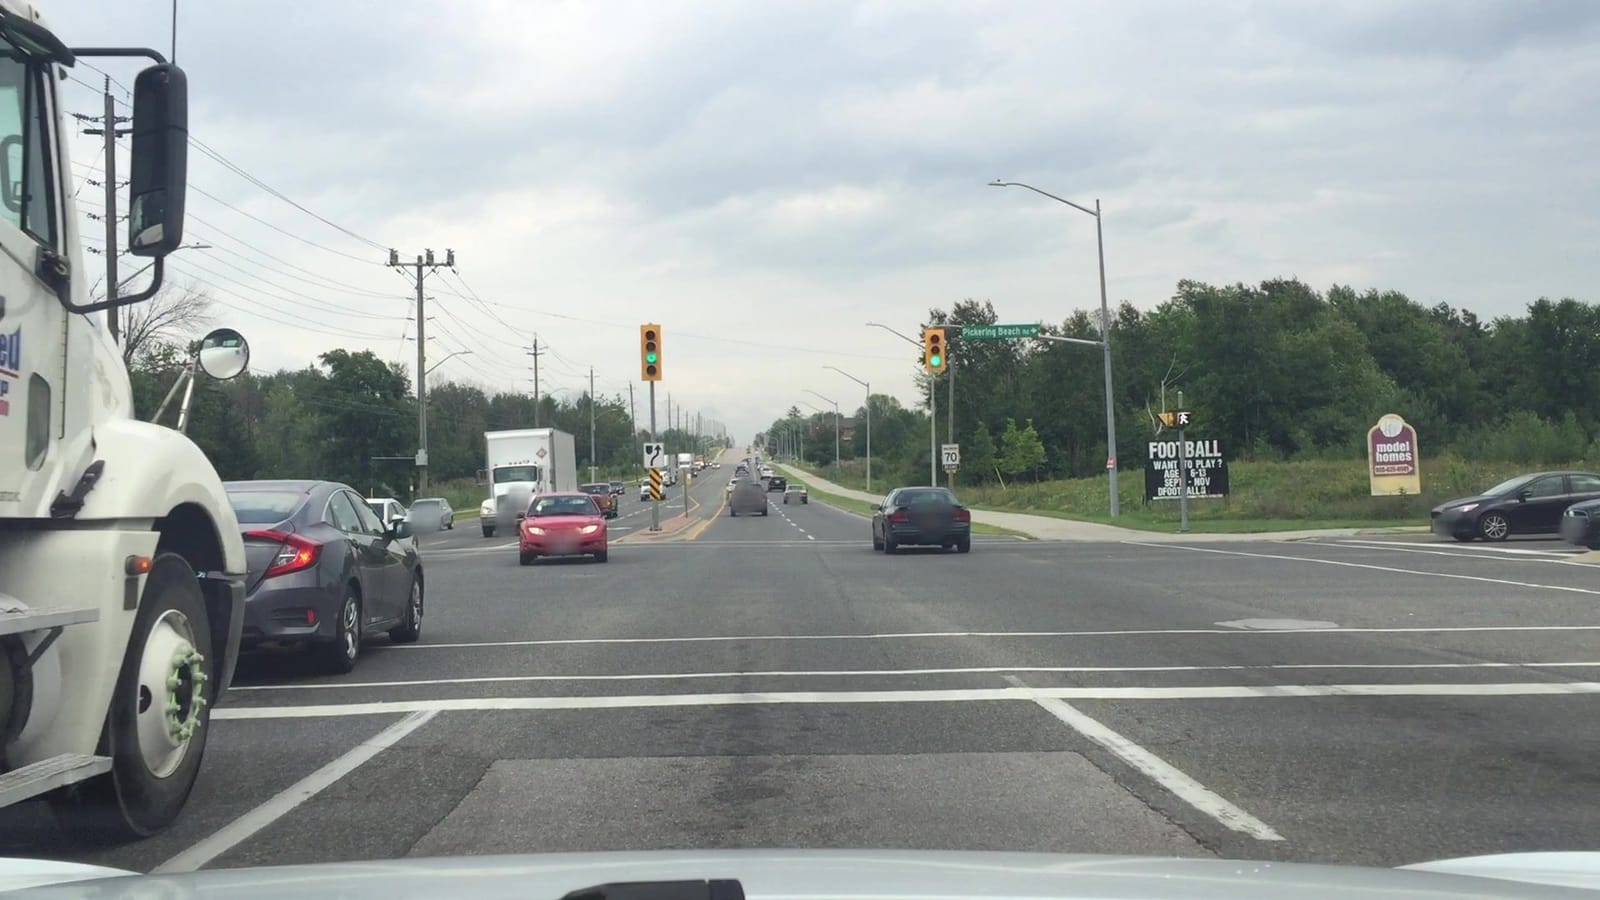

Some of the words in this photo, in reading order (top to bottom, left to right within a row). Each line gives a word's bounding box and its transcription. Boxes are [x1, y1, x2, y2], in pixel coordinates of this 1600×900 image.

[962, 328, 996, 337] Pickering
[998, 327, 1020, 335] Beach
[1149, 440, 1222, 459] FOOTBALL
[1376, 441, 1410, 453] model
[944, 452, 957, 462] 70
[1376, 452, 1412, 462] homes
[1153, 460, 1178, 470] WANT
[1193, 477, 1210, 486] NOV
